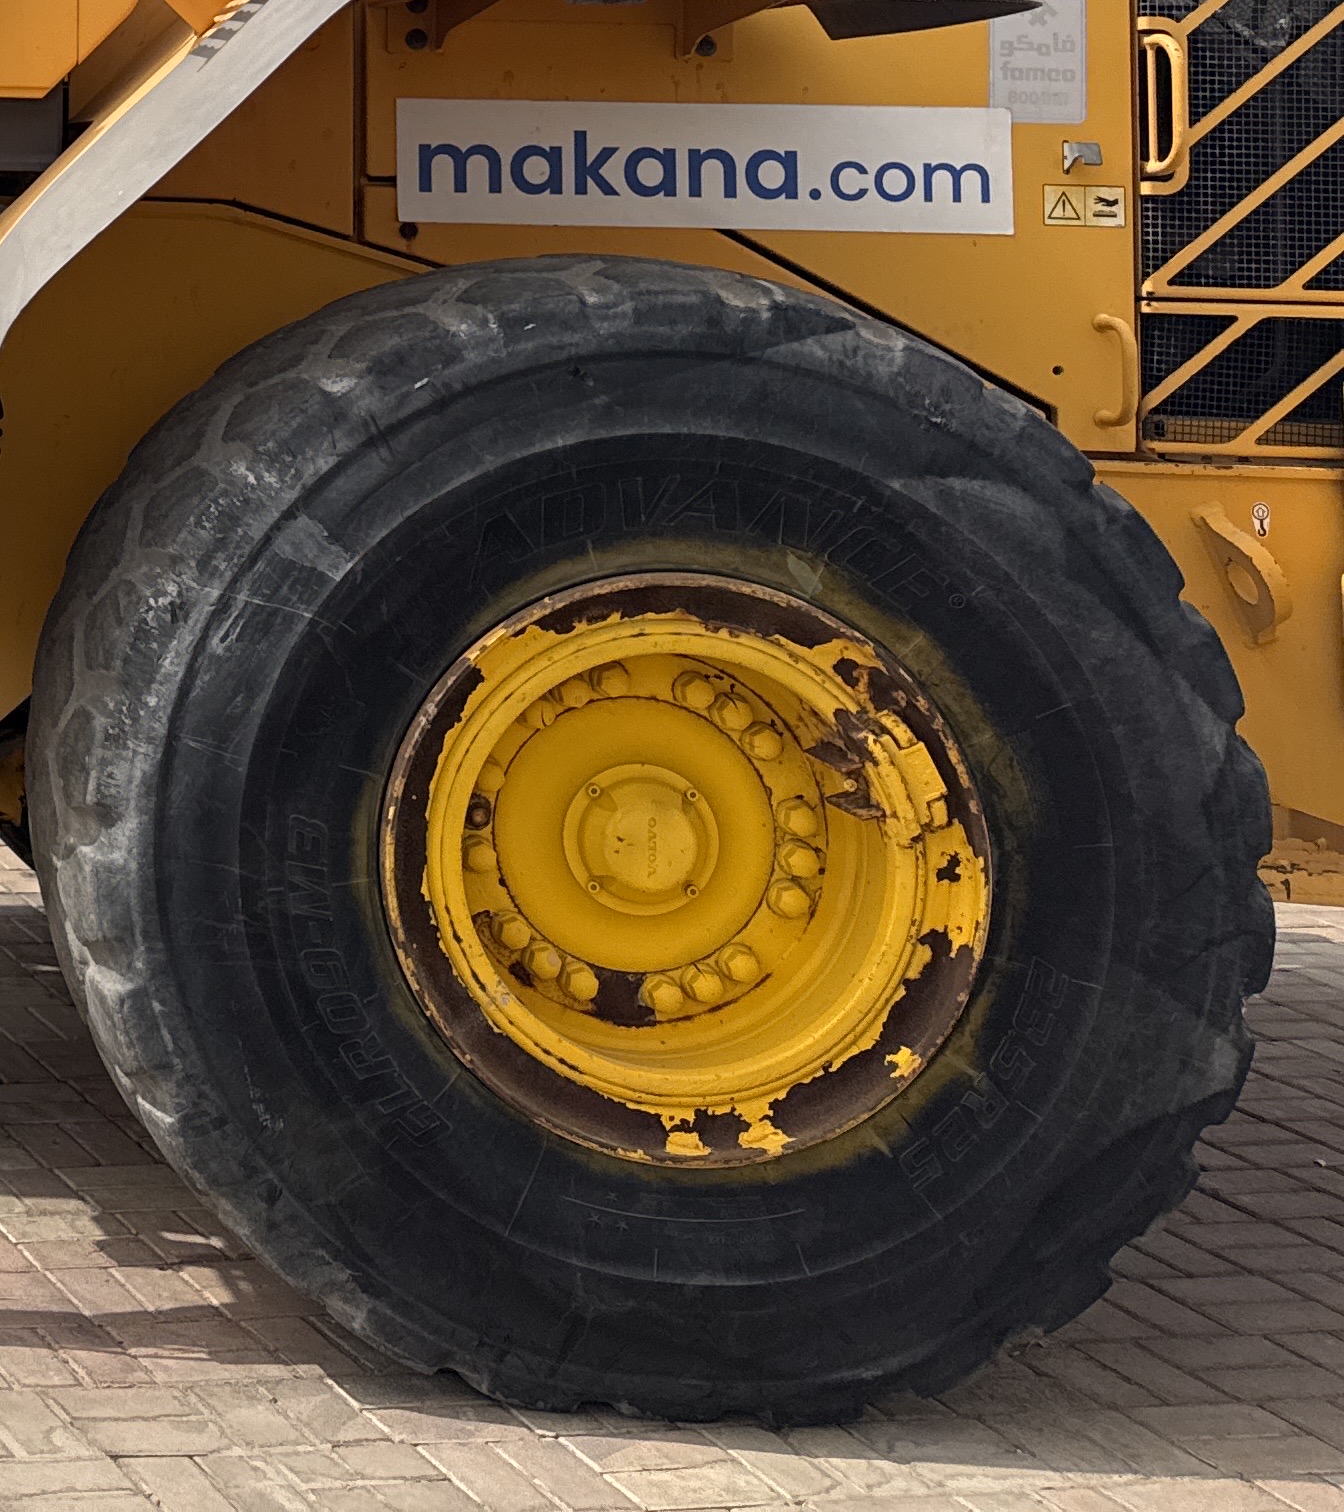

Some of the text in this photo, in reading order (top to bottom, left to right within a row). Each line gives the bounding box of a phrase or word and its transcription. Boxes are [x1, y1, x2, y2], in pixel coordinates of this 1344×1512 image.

[1000, 60, 1077, 83] famco
[418, 130, 991, 204] makana.com
[468, 473, 949, 611] ADVANCE
[647, 816, 658, 879] VOLVO
[286, 813, 453, 1148] GLR09-M3
